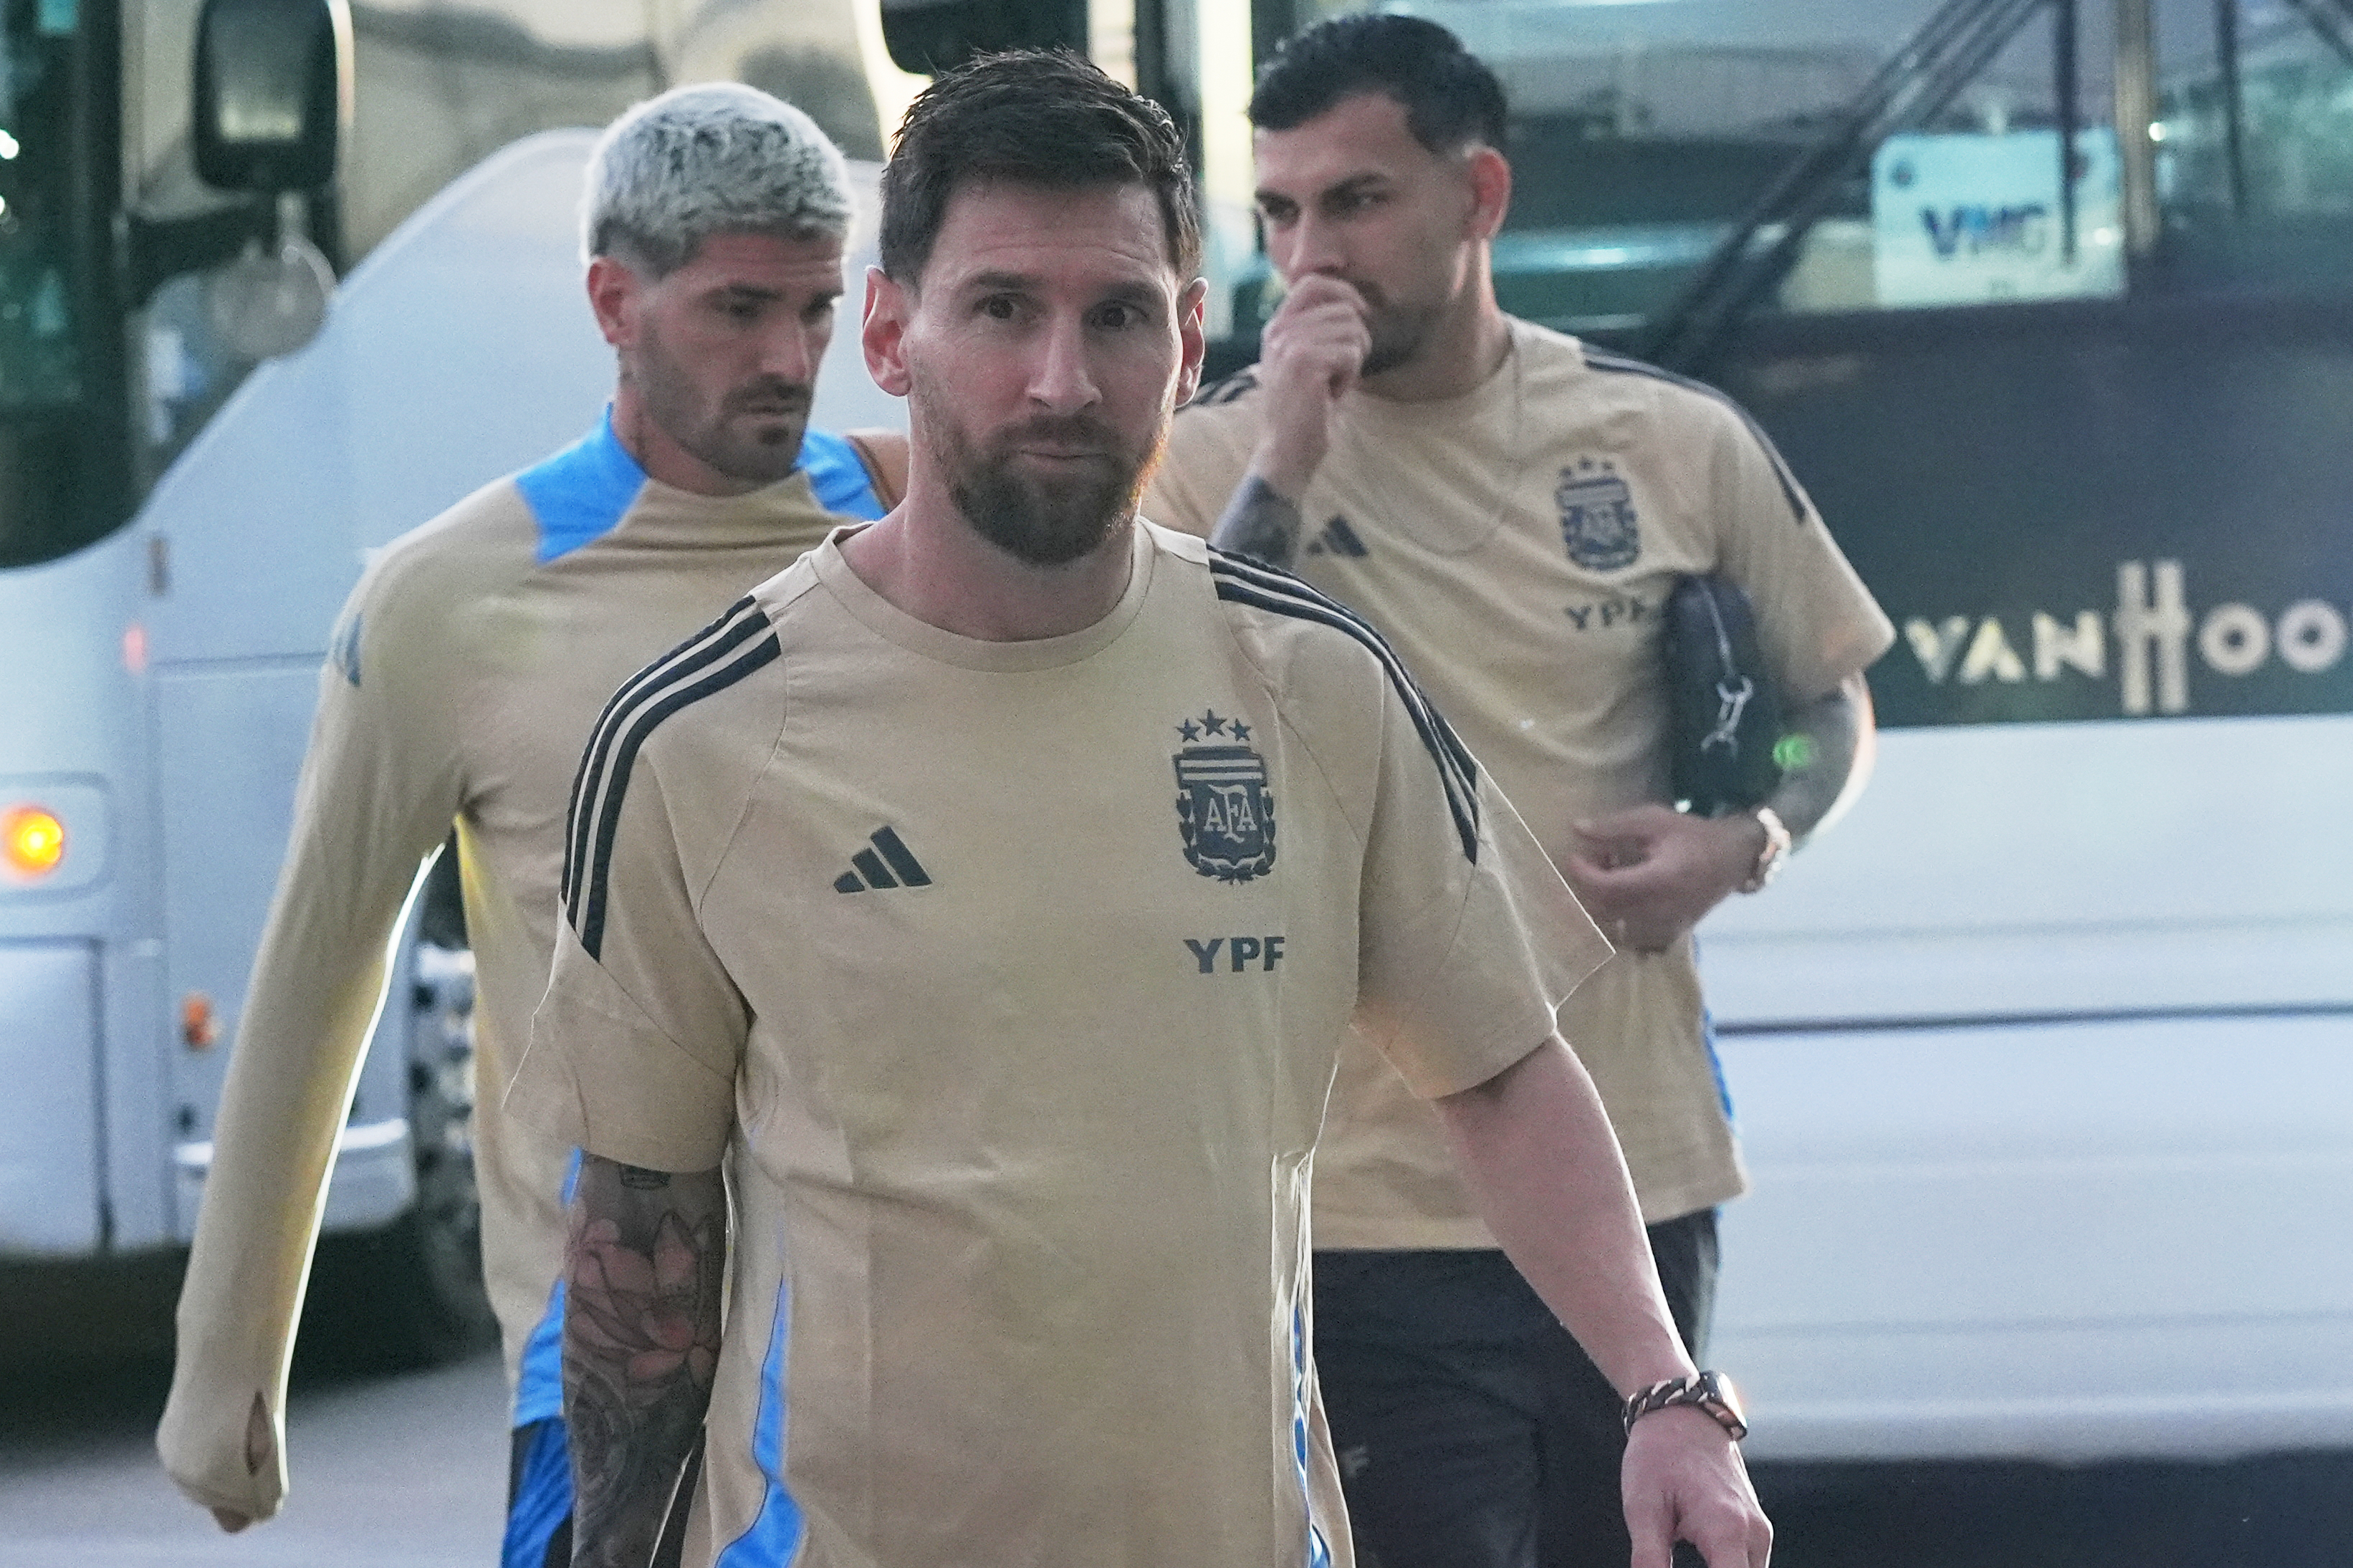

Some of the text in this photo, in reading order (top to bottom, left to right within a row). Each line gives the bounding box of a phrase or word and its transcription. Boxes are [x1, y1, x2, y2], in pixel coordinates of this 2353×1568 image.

[1565, 598, 1646, 630] YPF
[1204, 784, 1257, 843] AFA
[1183, 936, 1285, 974] YPF
